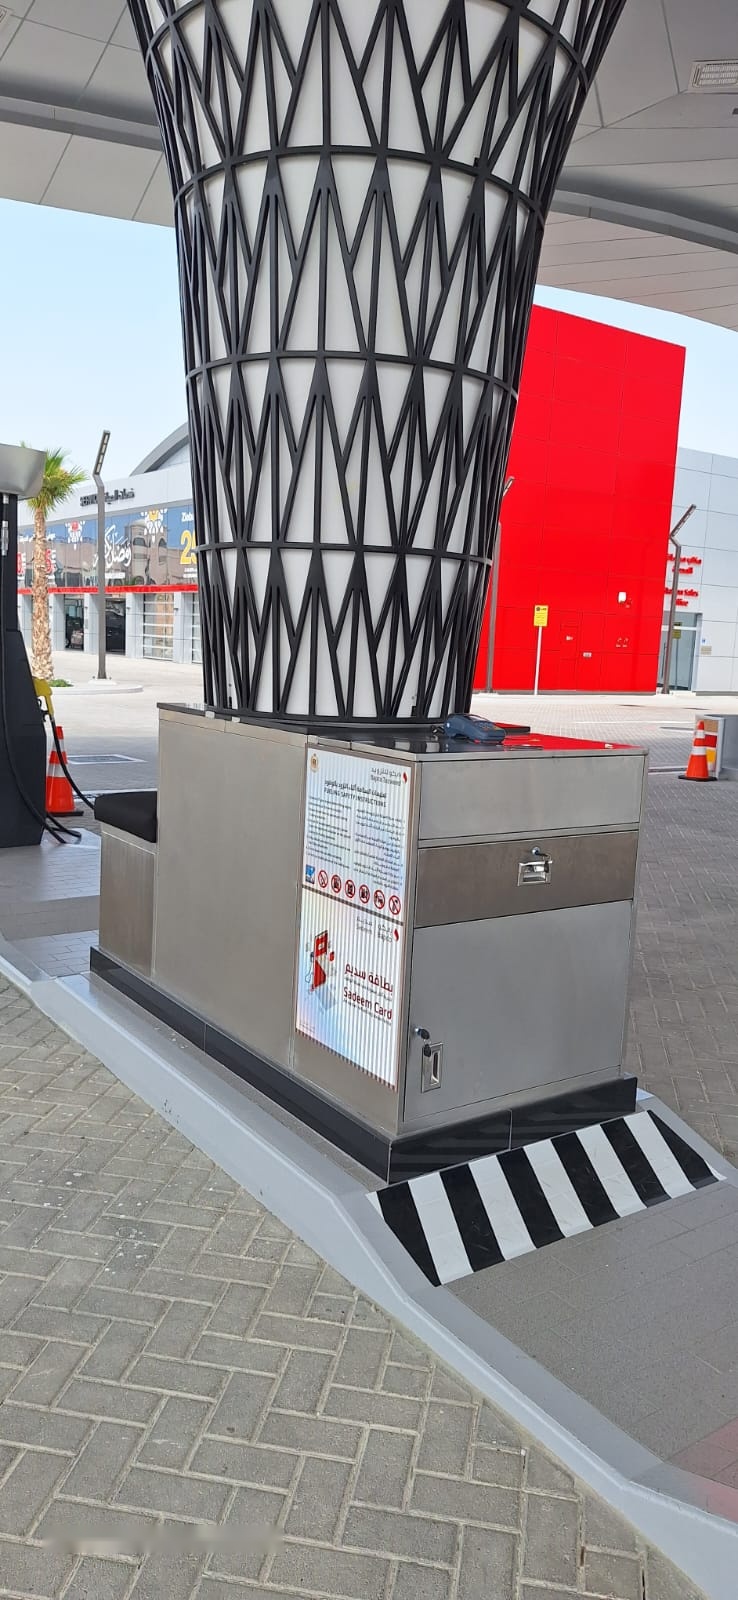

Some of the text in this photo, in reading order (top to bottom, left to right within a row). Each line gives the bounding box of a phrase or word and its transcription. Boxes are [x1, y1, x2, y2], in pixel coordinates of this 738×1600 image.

[345, 963, 366, 980] سديم
[368, 972, 393, 996] بطاقة
[343, 986, 373, 1010] Sadeem
[374, 1001, 393, 1020] Card
